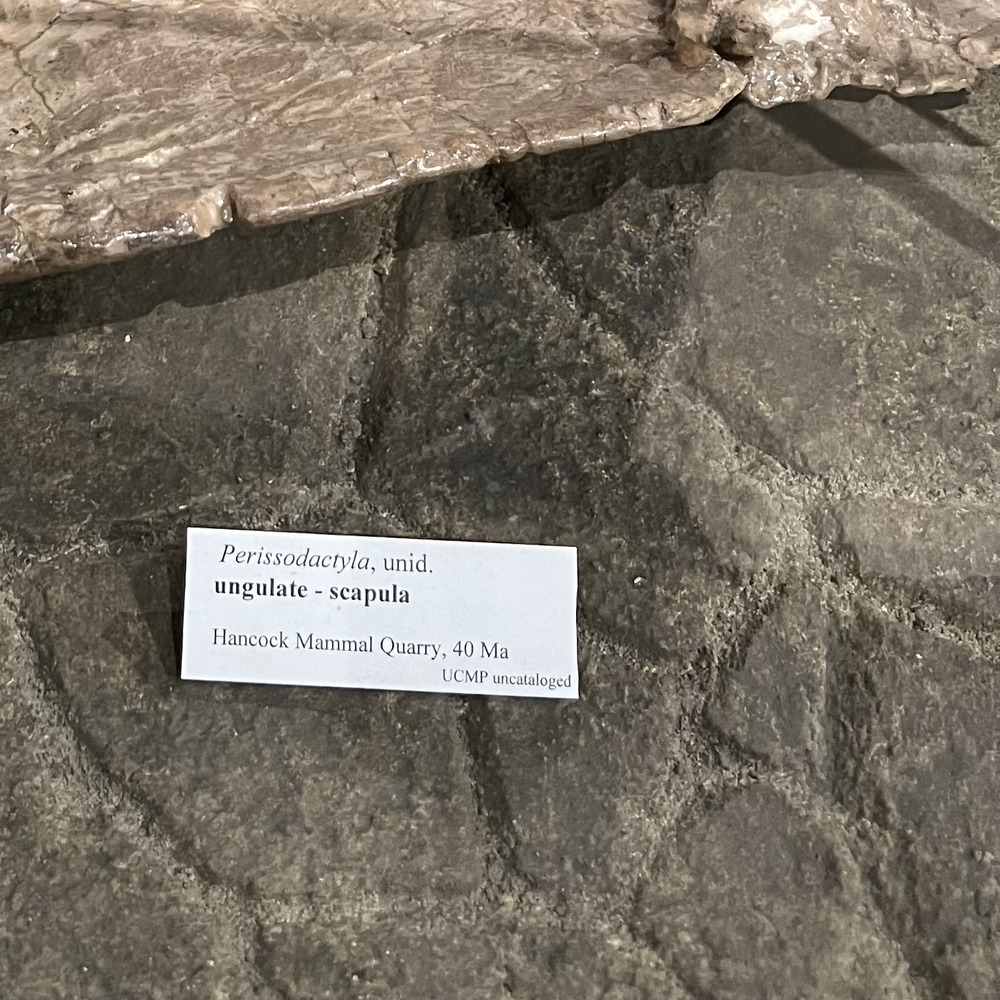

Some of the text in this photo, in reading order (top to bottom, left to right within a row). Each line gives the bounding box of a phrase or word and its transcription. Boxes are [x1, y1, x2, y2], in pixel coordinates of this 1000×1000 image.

[219, 543, 433, 573] Perissodactyla, unid.
[214, 578, 308, 600] ungulate
[329, 583, 410, 606] scapula
[212, 628, 509, 659] Hancock Mammal Quarry, 40 Ma
[442, 669, 572, 689] UCMP uncataloged
